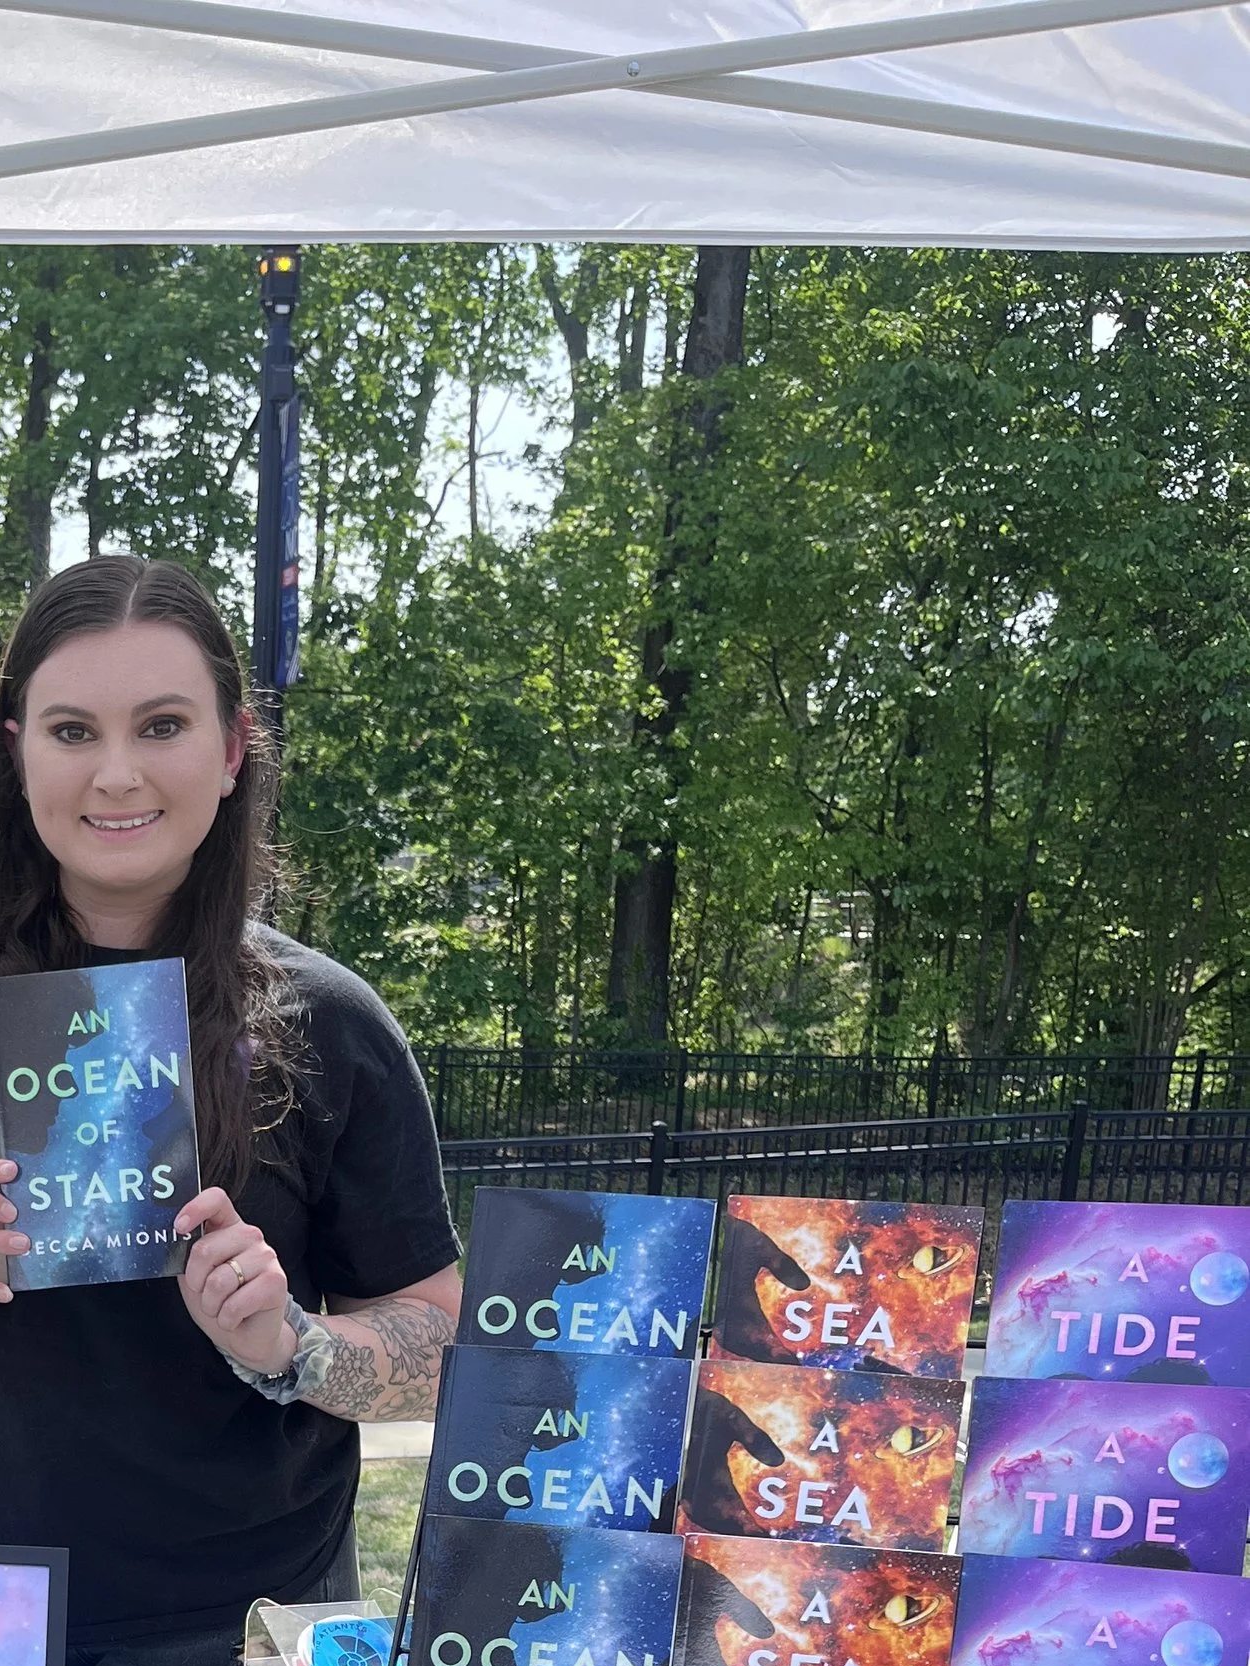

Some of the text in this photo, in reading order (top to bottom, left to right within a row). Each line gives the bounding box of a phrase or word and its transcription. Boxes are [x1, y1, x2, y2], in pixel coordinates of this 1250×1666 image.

[67, 1009, 109, 1035] AN
[6, 1052, 180, 1102] OCEAN
[76, 1119, 117, 1145] OF
[28, 1164, 175, 1211] STARS
[24, 1238, 95, 1256] ECCA
[561, 1244, 616, 1272] AN
[834, 1243, 864, 1276] A
[1118, 1253, 1149, 1283] A
[477, 1295, 687, 1350] OCEAN
[782, 1301, 896, 1348] SEA
[1051, 1311, 1201, 1360] TIDE
[533, 1409, 589, 1438] AN
[809, 1419, 840, 1454] A
[1094, 1433, 1126, 1464] A
[448, 1462, 663, 1519] OCEAN
[755, 1477, 872, 1531] SEA
[1025, 1491, 1180, 1544] TIDE
[518, 1580, 576, 1611] AN
[800, 1591, 832, 1625] A
[1086, 1617, 1117, 1649] A
